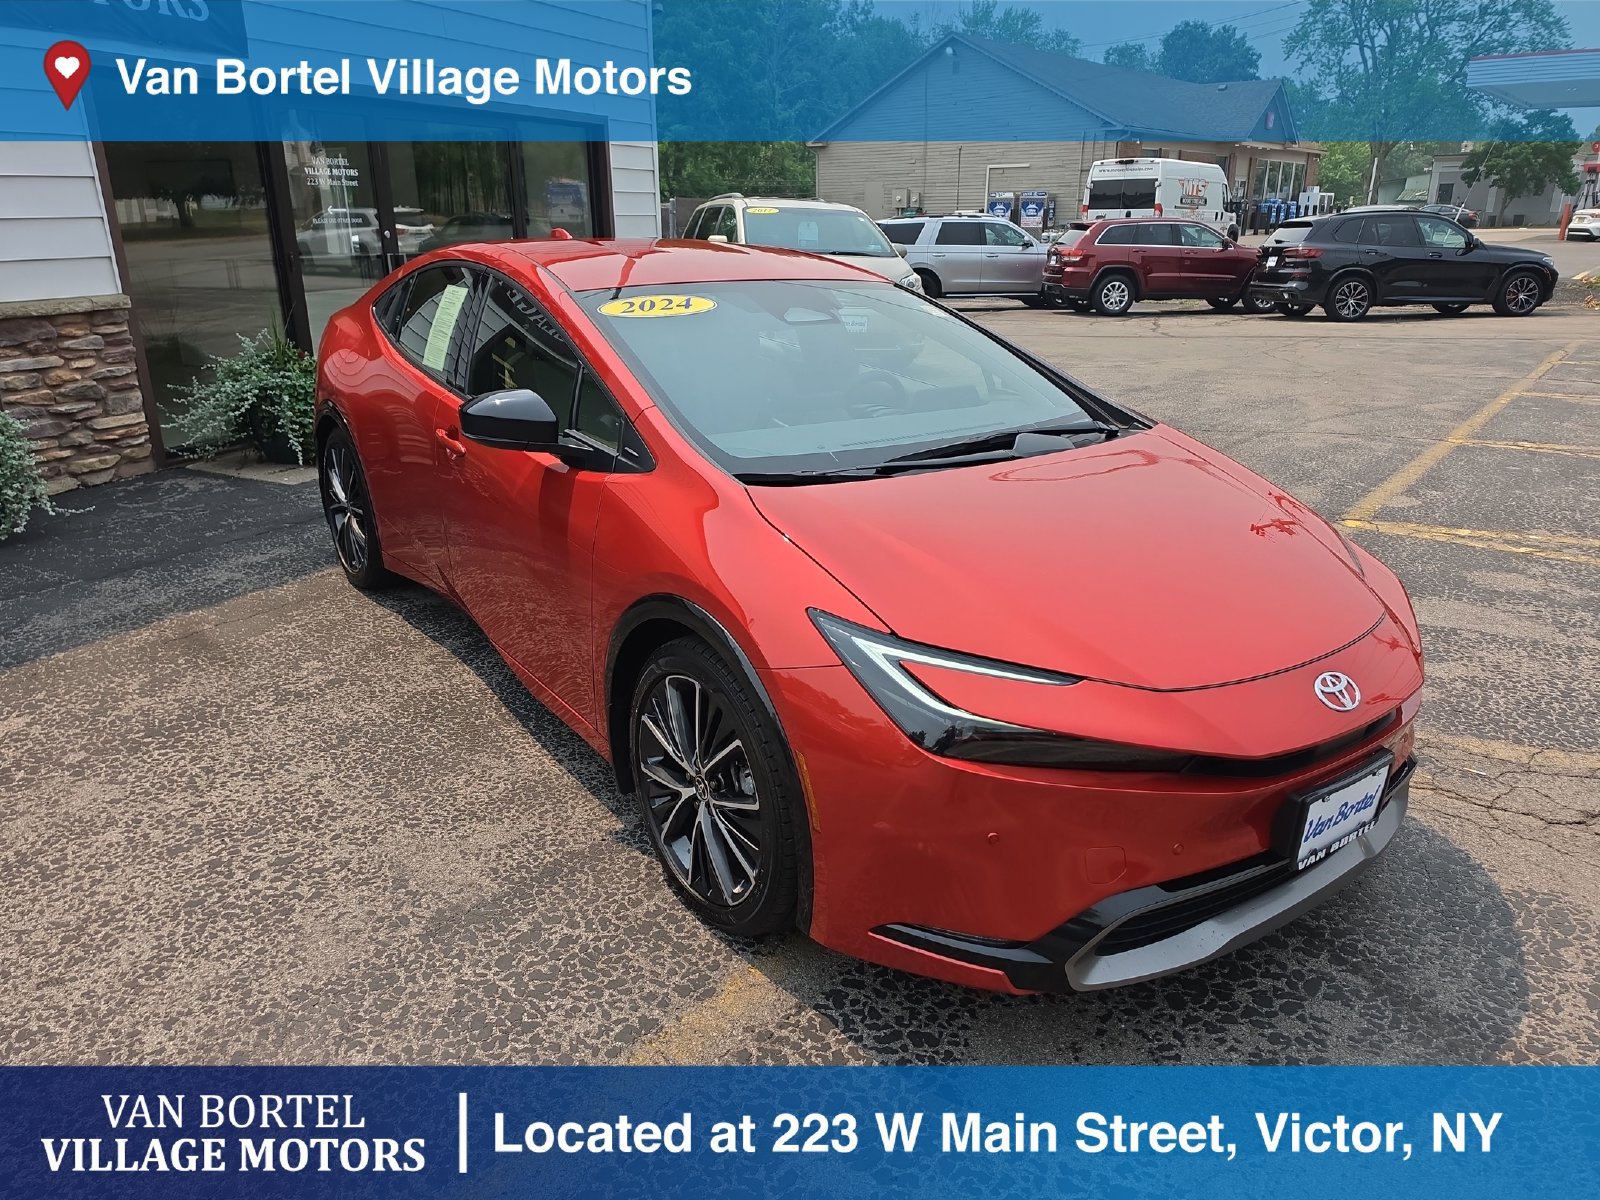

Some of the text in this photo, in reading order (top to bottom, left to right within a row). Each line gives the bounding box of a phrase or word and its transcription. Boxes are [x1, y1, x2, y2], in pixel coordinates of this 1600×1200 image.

[312, 156, 349, 166] VAN BORTEL
[304, 167, 359, 177] VILLAGE MOTORS
[306, 177, 319, 186] 223
[328, 178, 341, 186] Main
[342, 178, 359, 187] Street
[620, 297, 692, 314] 2024
[1303, 784, 1381, 843] Van Bortel
[1298, 821, 1376, 870] VAN BORTEL
